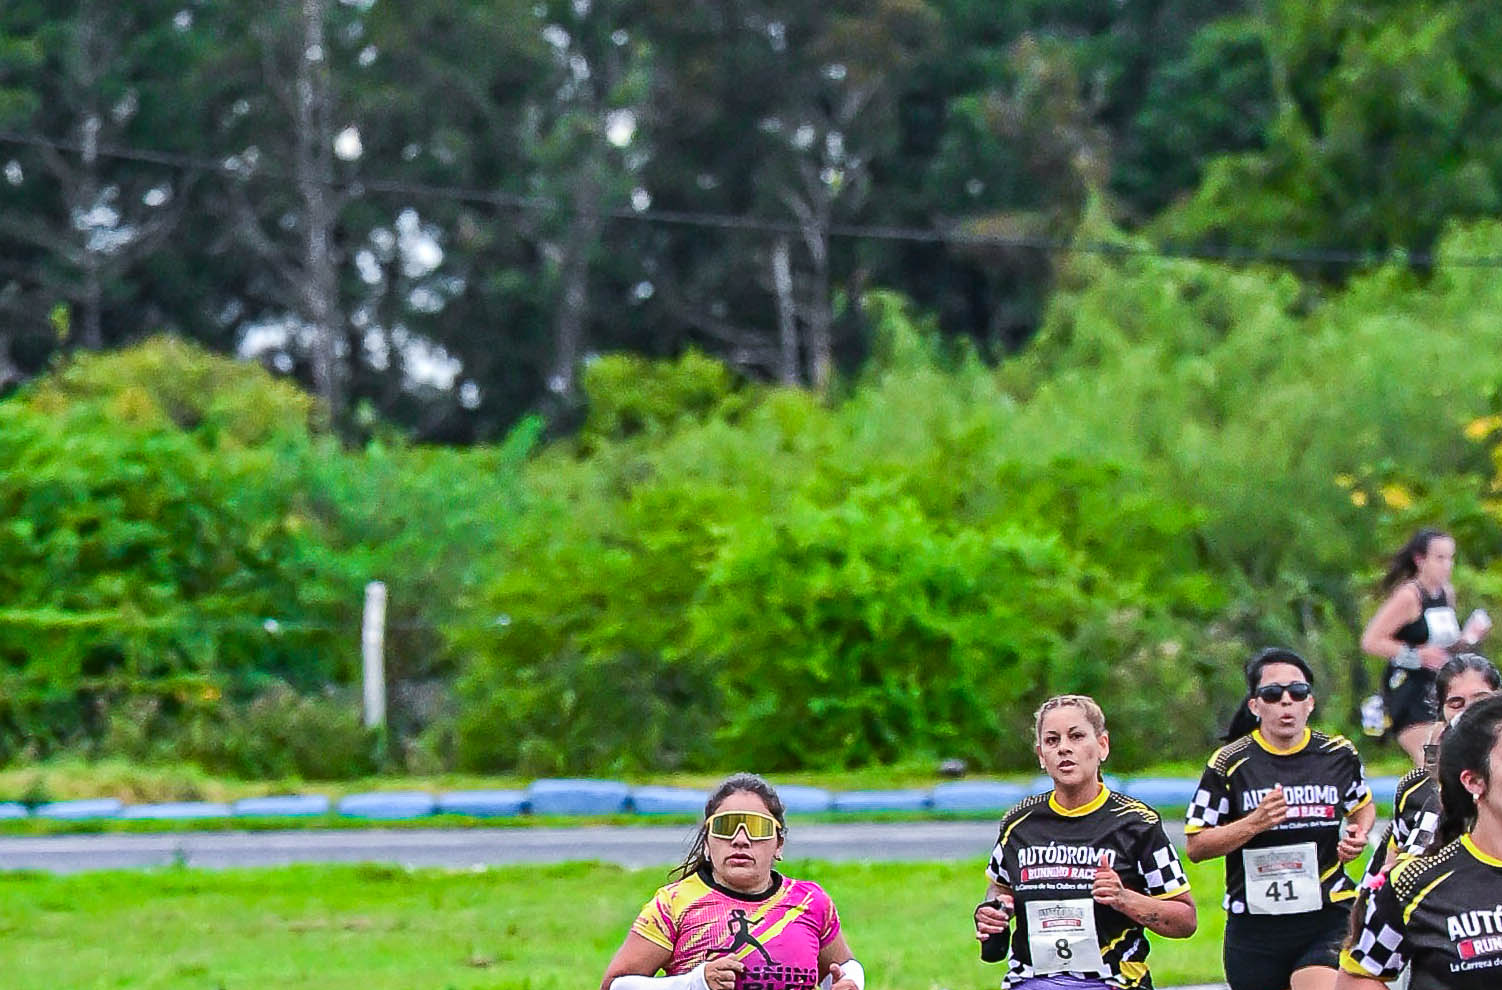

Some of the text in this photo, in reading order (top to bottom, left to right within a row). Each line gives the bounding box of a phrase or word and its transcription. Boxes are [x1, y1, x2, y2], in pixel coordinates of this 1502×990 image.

[1242, 782, 1340, 811] AUDROMO
[1017, 840, 1116, 869] AUTÓDROMO
[1071, 867, 1097, 880] RACE
[1265, 880, 1299, 902] 41
[1056, 938, 1073, 960] 8
[1450, 962, 1459, 973] La
